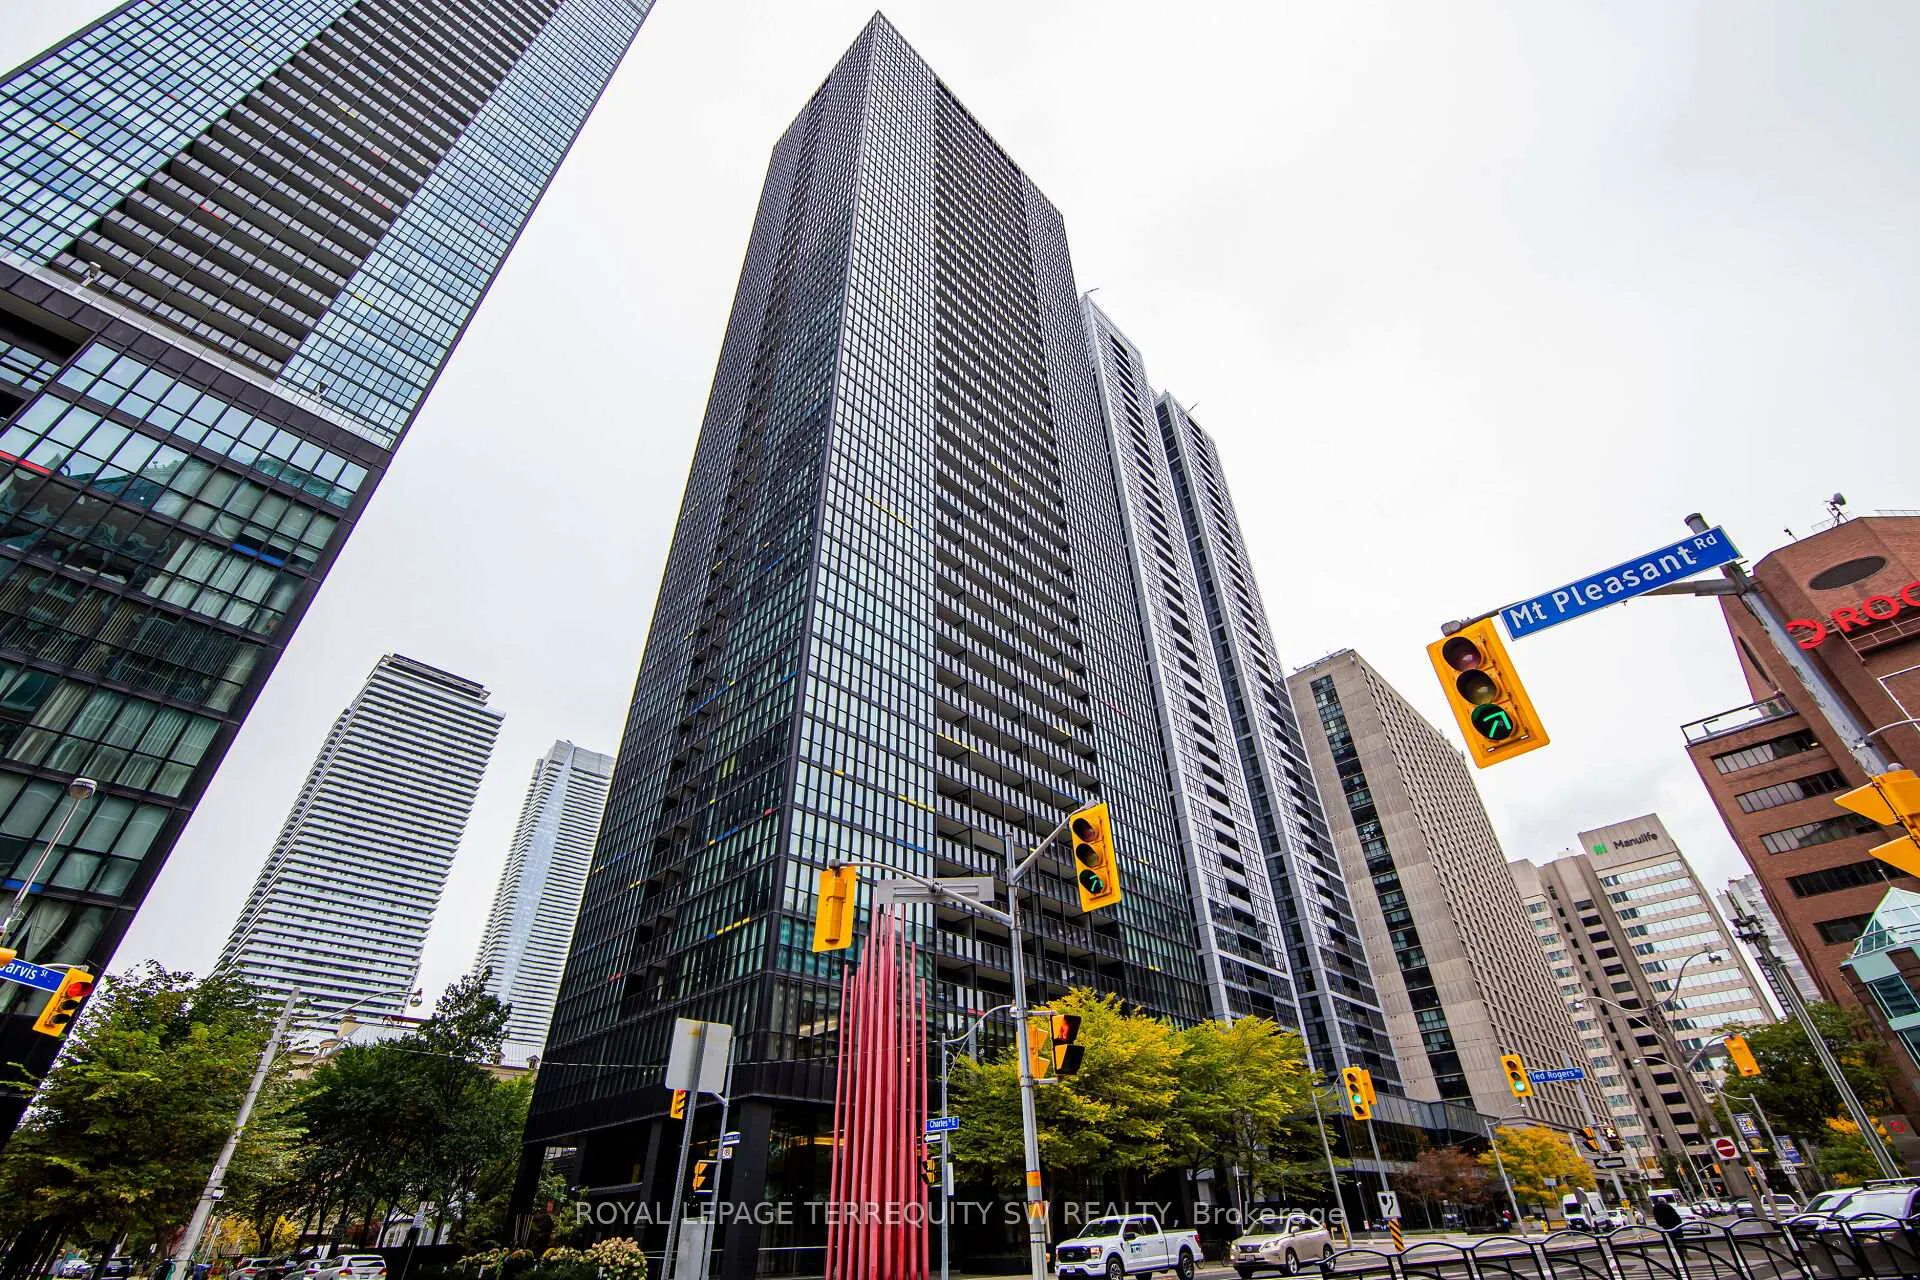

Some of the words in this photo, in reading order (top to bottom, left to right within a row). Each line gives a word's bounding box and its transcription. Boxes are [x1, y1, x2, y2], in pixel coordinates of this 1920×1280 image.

[1508, 601, 1548, 629] Mt
[1552, 545, 1697, 613] Pleasant
[1693, 533, 1718, 551] Rd
[1613, 831, 1658, 850] Manulife
[40, 969, 49, 978] St
[1532, 1072, 1546, 1081] Ted
[1547, 1070, 1575, 1080] Rogers
[929, 1119, 949, 1129] Charles
